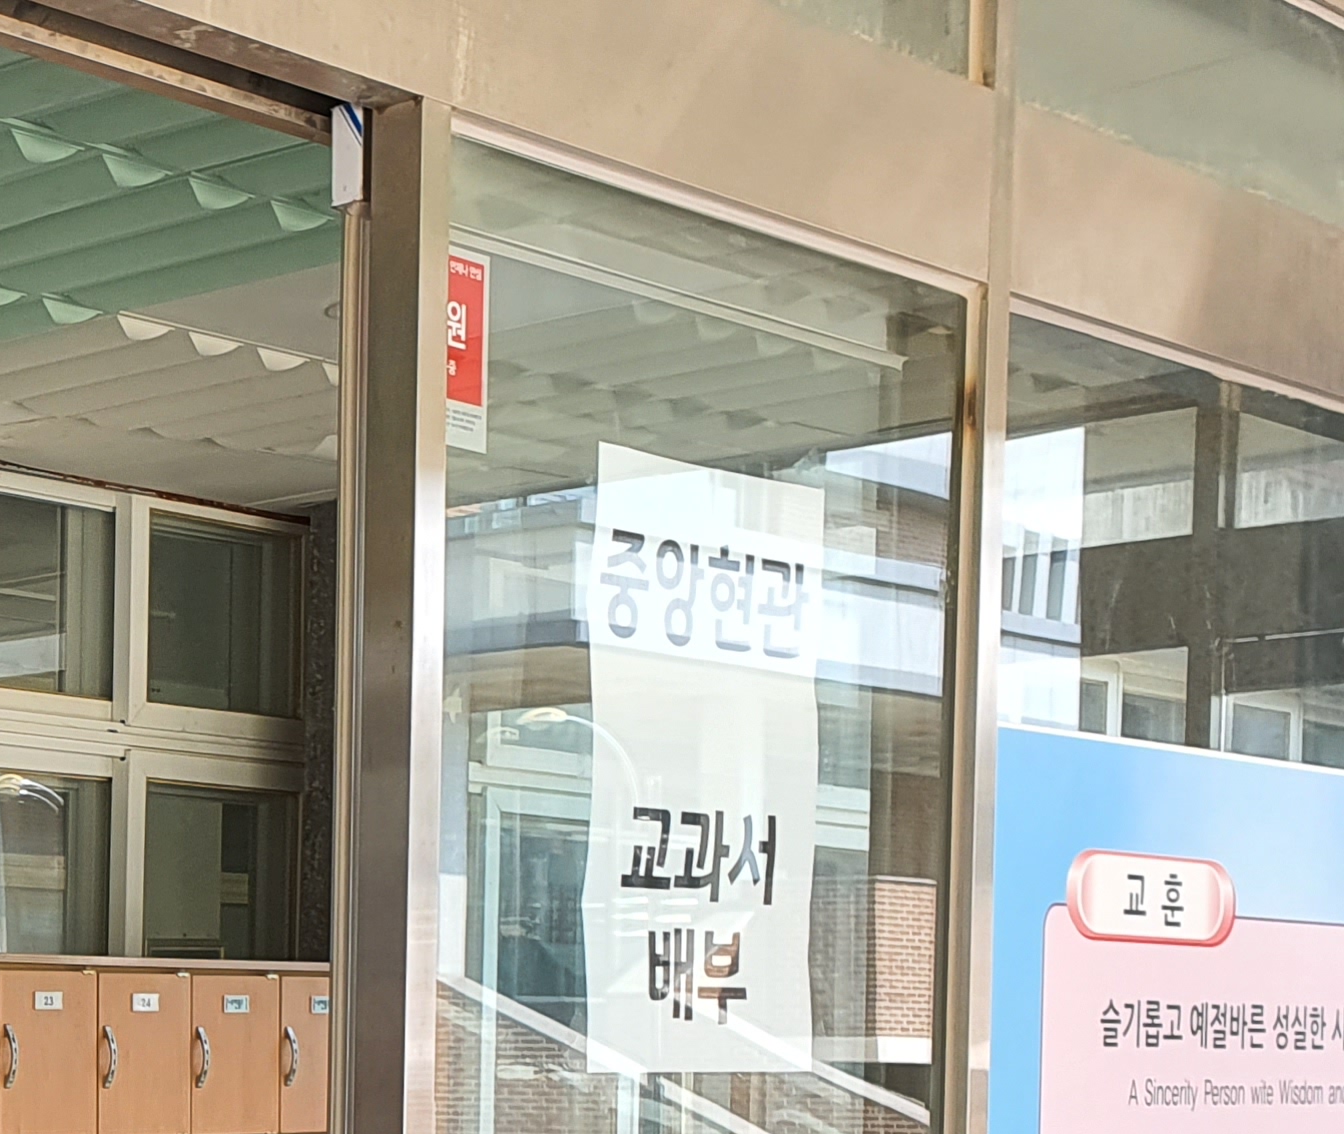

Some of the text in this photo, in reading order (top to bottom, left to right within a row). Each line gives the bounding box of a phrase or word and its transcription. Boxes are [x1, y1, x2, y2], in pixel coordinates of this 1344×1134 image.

[599, 528, 810, 659] 중앙현관
[620, 806, 777, 906] 교과서
[1123, 873, 1185, 927] 교훈
[43, 995, 55, 1006] 23
[648, 928, 747, 1025] 배부
[1100, 999, 1183, 1049] 슬기롭고
[1189, 1002, 1267, 1050] 예절바른
[1273, 1005, 1327, 1051] 성실한
[1128, 1080, 1139, 1106] A
[1144, 1078, 1199, 1111] Sincerity
[1203, 1080, 1246, 1106] Person
[1278, 1081, 1324, 1106] Wisdom
